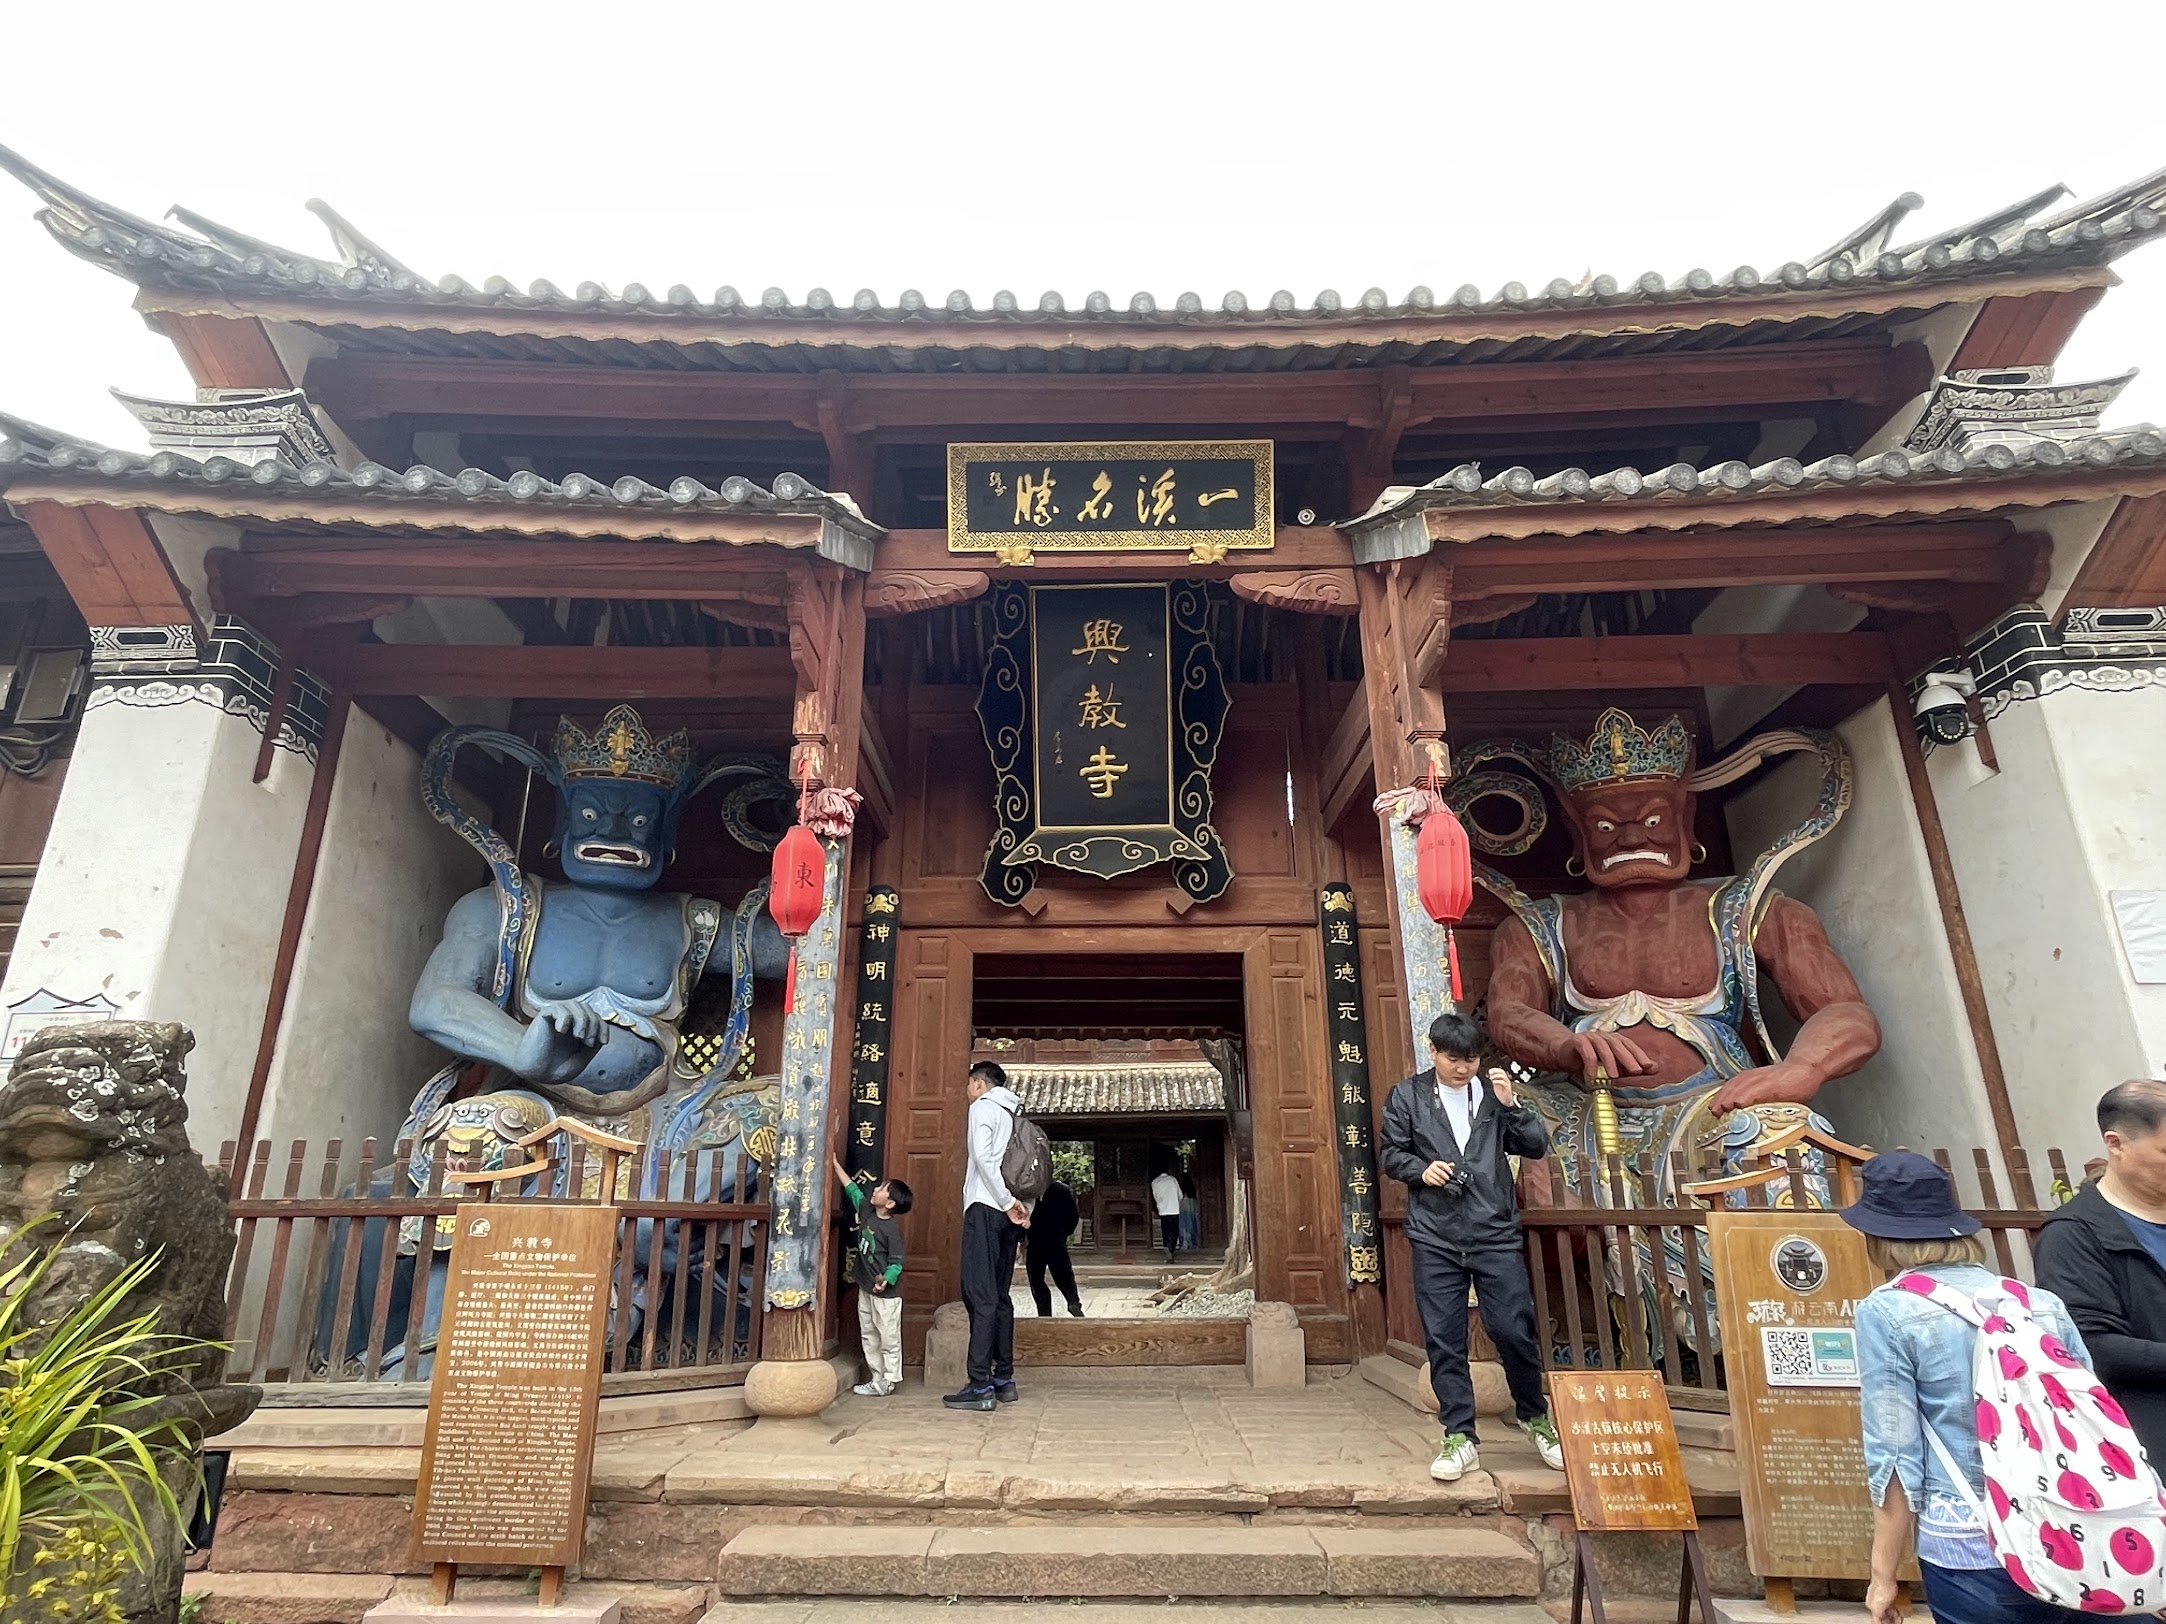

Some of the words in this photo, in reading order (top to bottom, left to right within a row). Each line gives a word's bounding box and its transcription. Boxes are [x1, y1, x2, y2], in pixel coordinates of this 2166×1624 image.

[1072, 619, 1130, 799] 興教寺
[511, 1236, 553, 1249] 兴教寺
[1569, 1420, 1664, 1435] 沙溪古镇核心保护区
[1590, 1441, 1654, 1455] 上空未经批准
[1588, 1461, 1664, 1476] 禁止无人机飞行
[2038, 1475, 2048, 1492] 5
[2070, 1524, 2084, 1542] 6
[2125, 1532, 2138, 1550] 5
[2134, 1588, 2144, 1606] 8
